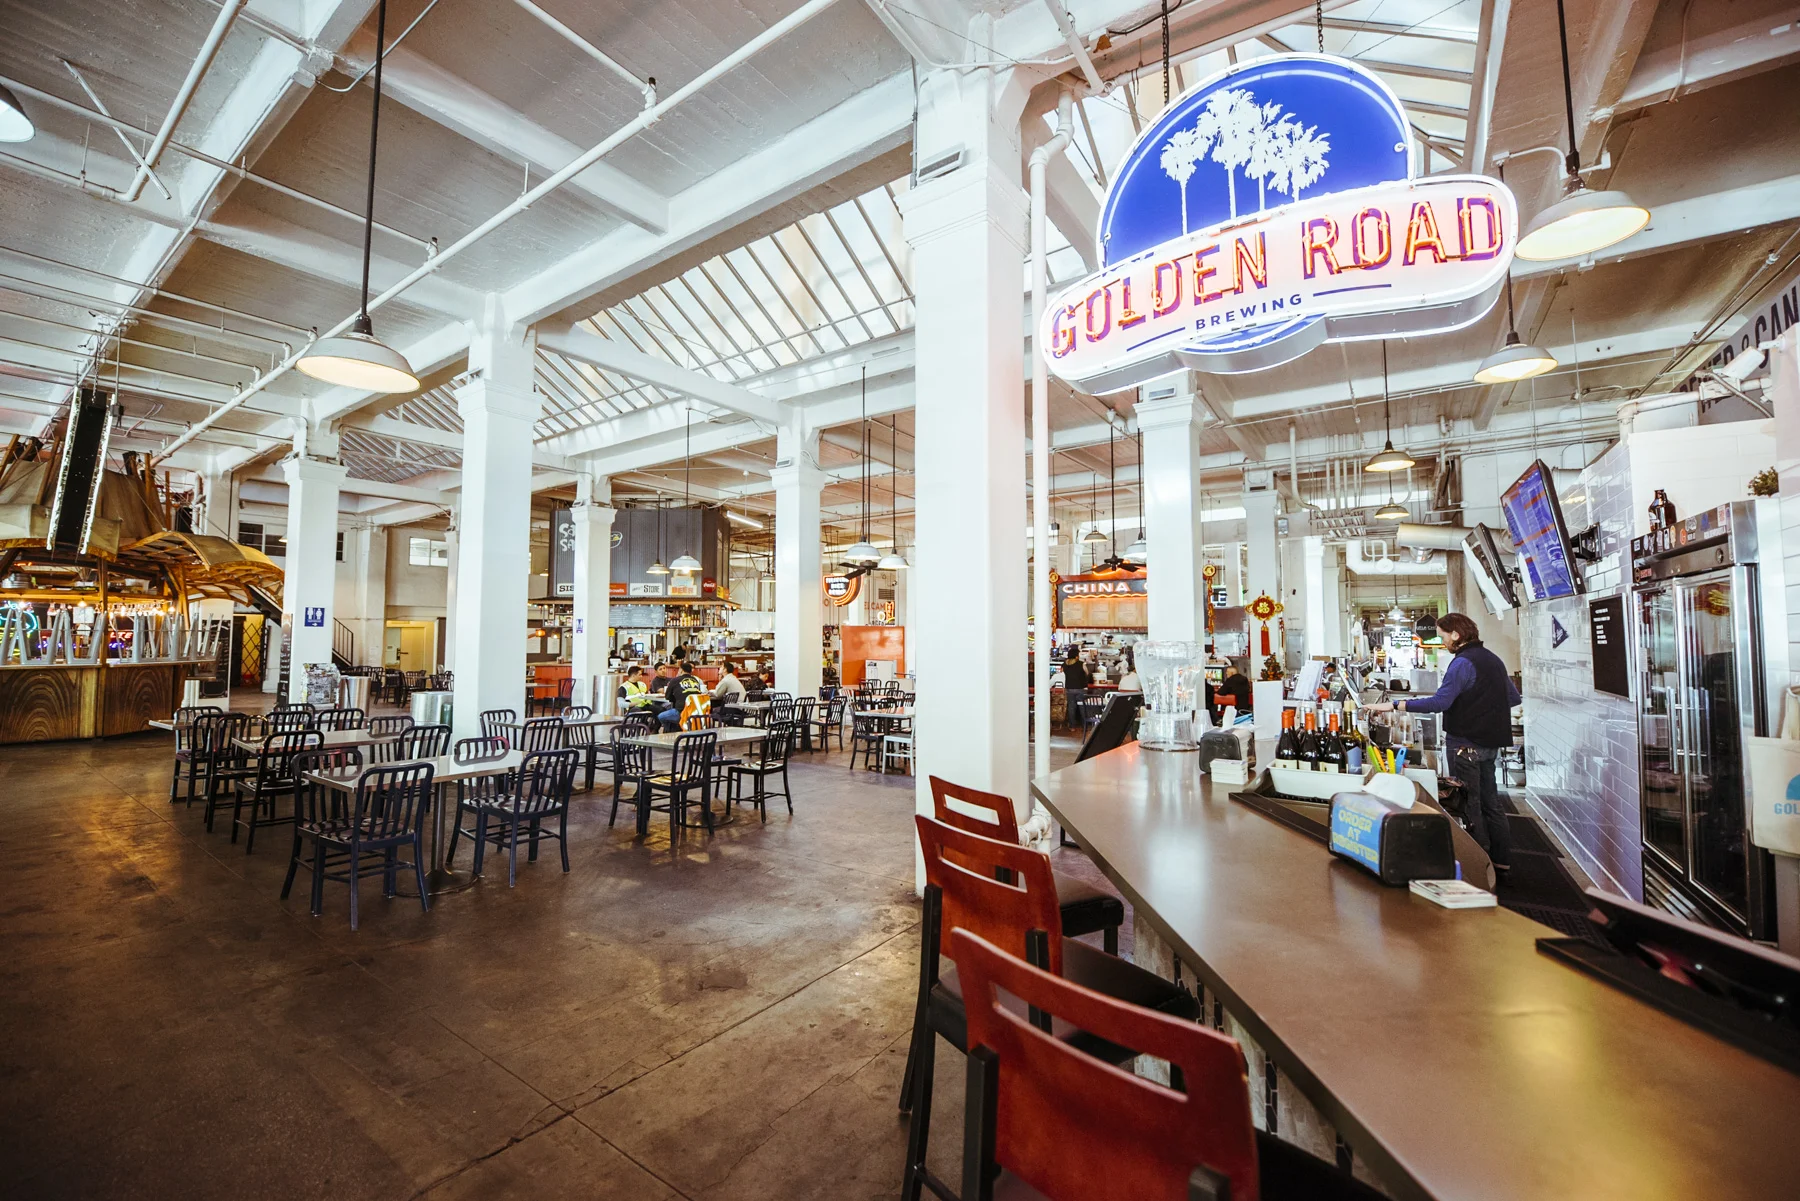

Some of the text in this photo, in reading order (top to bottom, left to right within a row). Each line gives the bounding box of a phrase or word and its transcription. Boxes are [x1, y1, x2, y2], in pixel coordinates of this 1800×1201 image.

[1052, 194, 1504, 358] GOLDEN ROAD
[1196, 294, 1302, 330] BREWING
[1062, 582, 1130, 594] CHINA
[1338, 809, 1373, 833] ORDER
[1347, 826, 1361, 841] AT
